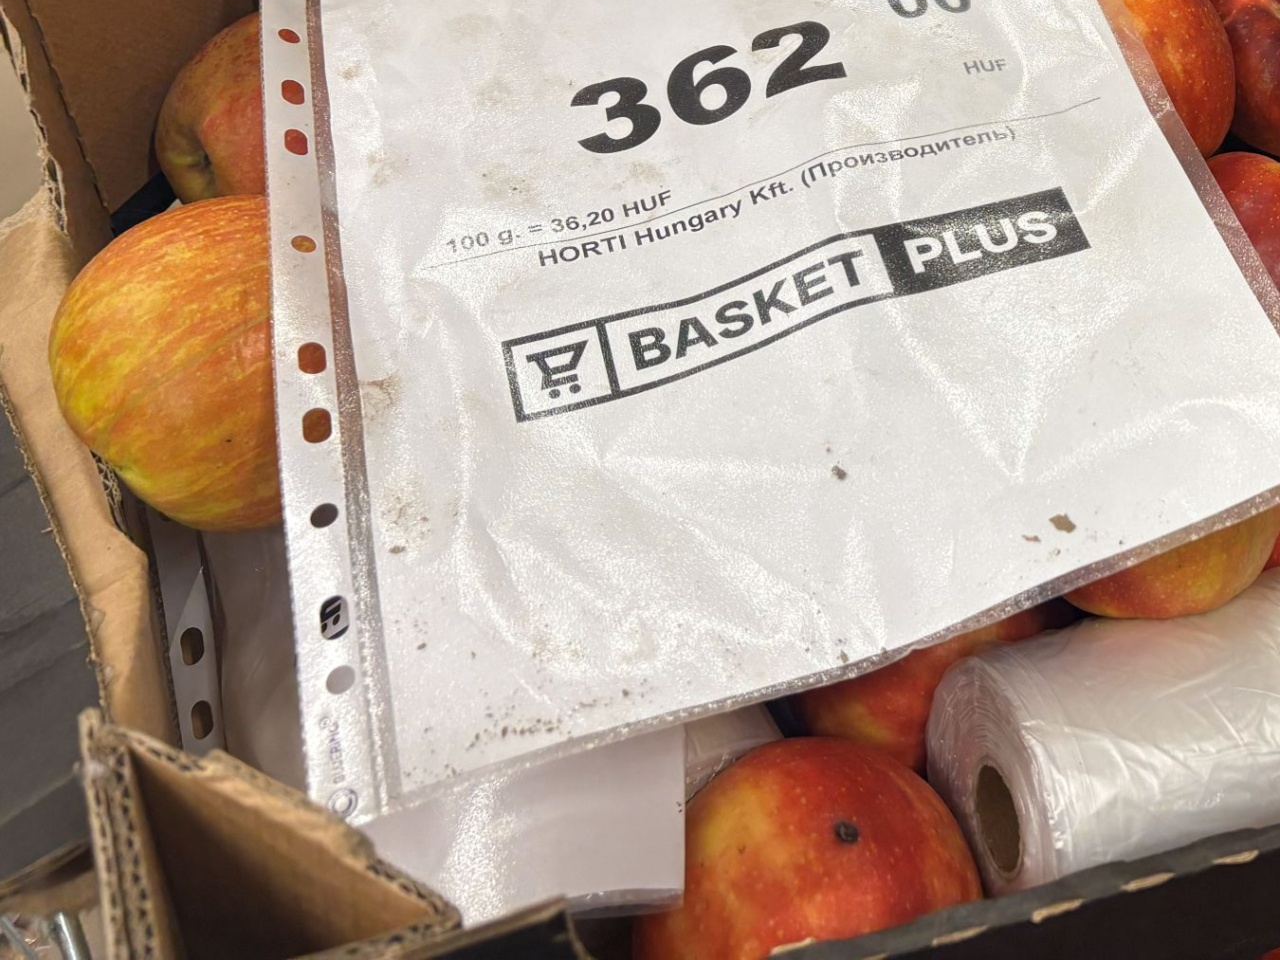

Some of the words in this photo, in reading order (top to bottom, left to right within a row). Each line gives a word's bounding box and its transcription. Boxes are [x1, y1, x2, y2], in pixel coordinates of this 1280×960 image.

[569, 19, 848, 155] 362
[962, 58, 1008, 76] HUF
[445, 230, 490, 254] 100
[497, 228, 522, 246] g.
[527, 222, 543, 234] =
[550, 207, 615, 234] 36,20
[622, 189, 672, 218] HUF
[538, 234, 627, 267] HORTI
[634, 199, 743, 246] Hungary
[748, 179, 795, 206] Kft.
[800, 124, 1017, 189] (Производитель)
[627, 248, 867, 372] BASKET
[903, 210, 1059, 275] PLUS
